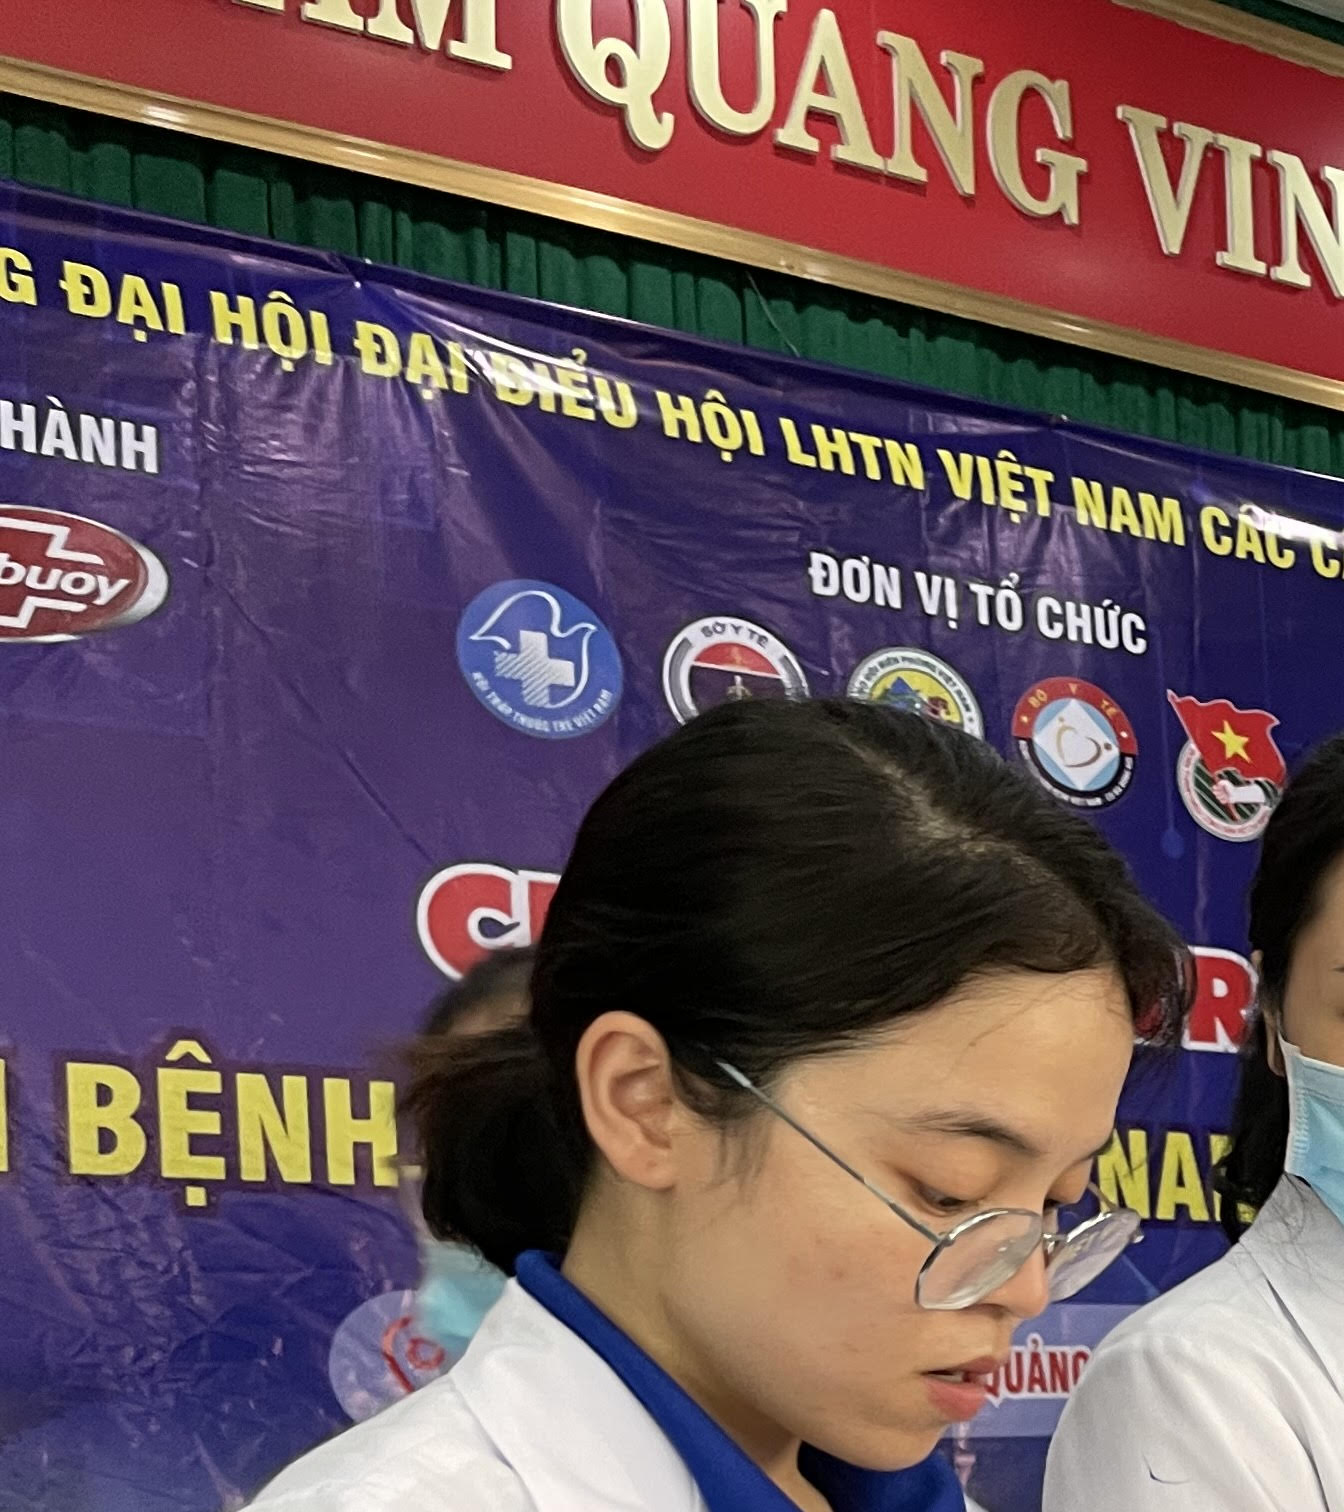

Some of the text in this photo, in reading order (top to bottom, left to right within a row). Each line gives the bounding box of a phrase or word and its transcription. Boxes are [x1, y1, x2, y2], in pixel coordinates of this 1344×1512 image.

[556, 0, 1088, 226] QUANG
[59, 260, 187, 343] ĐẠI
[211, 291, 333, 373] HỘI
[353, 322, 471, 400] ĐẠI
[661, 388, 766, 475] HỘI
[786, 421, 925, 490] LHTN
[935, 449, 1055, 526] VIỆT
[1073, 478, 1188, 548] NAM
[808, 551, 1148, 656] ĐƠN VỊ TỔ CHỨC
[65, 1040, 399, 1207] BỆNH
